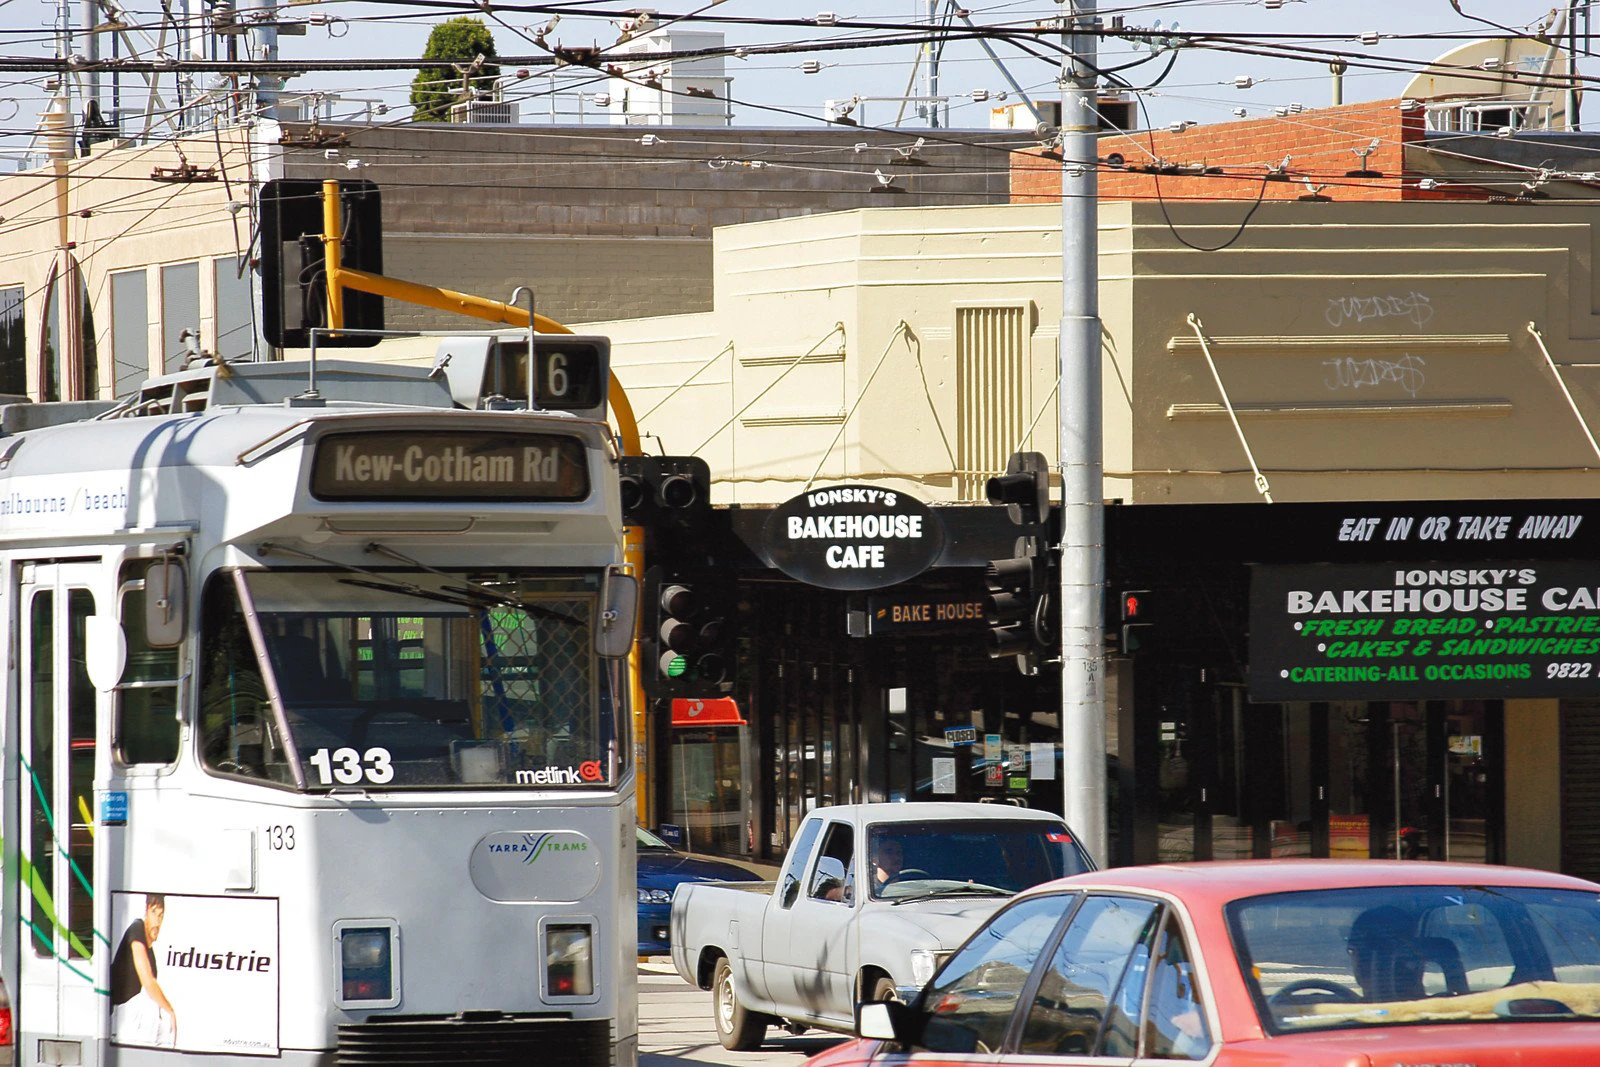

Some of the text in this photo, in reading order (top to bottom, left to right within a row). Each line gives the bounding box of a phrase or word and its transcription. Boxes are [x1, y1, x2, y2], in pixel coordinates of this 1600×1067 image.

[335, 445, 559, 483] Kew-Cotham Rd
[85, 486, 128, 510] beach
[808, 488, 897, 507] IONSKY'S
[787, 515, 922, 539] BAKEHOUSE
[1338, 515, 1582, 541] EAT IN OR TAKE AWAY
[826, 545, 885, 568] CAFE
[1395, 569, 1537, 586] IONSKY'S
[1287, 586, 1600, 614] BAKEHOUSE CA
[892, 602, 984, 622] BAKE HOUSE
[1301, 619, 1384, 637] FRESH
[1326, 637, 1600, 659] CAKES & SANDWICHES
[1082, 661, 1098, 673] 135
[1290, 664, 1420, 683] CATERING-ALL
[1424, 663, 1532, 681] OCCASIONS
[1546, 662, 1593, 679] 9822
[946, 730, 975, 743] CLOSED
[310, 747, 394, 785] 133
[516, 766, 581, 784] metlink
[265, 825, 296, 851] 133
[489, 843, 588, 853] YARRA TRAMS
[166, 945, 271, 973] industrie
